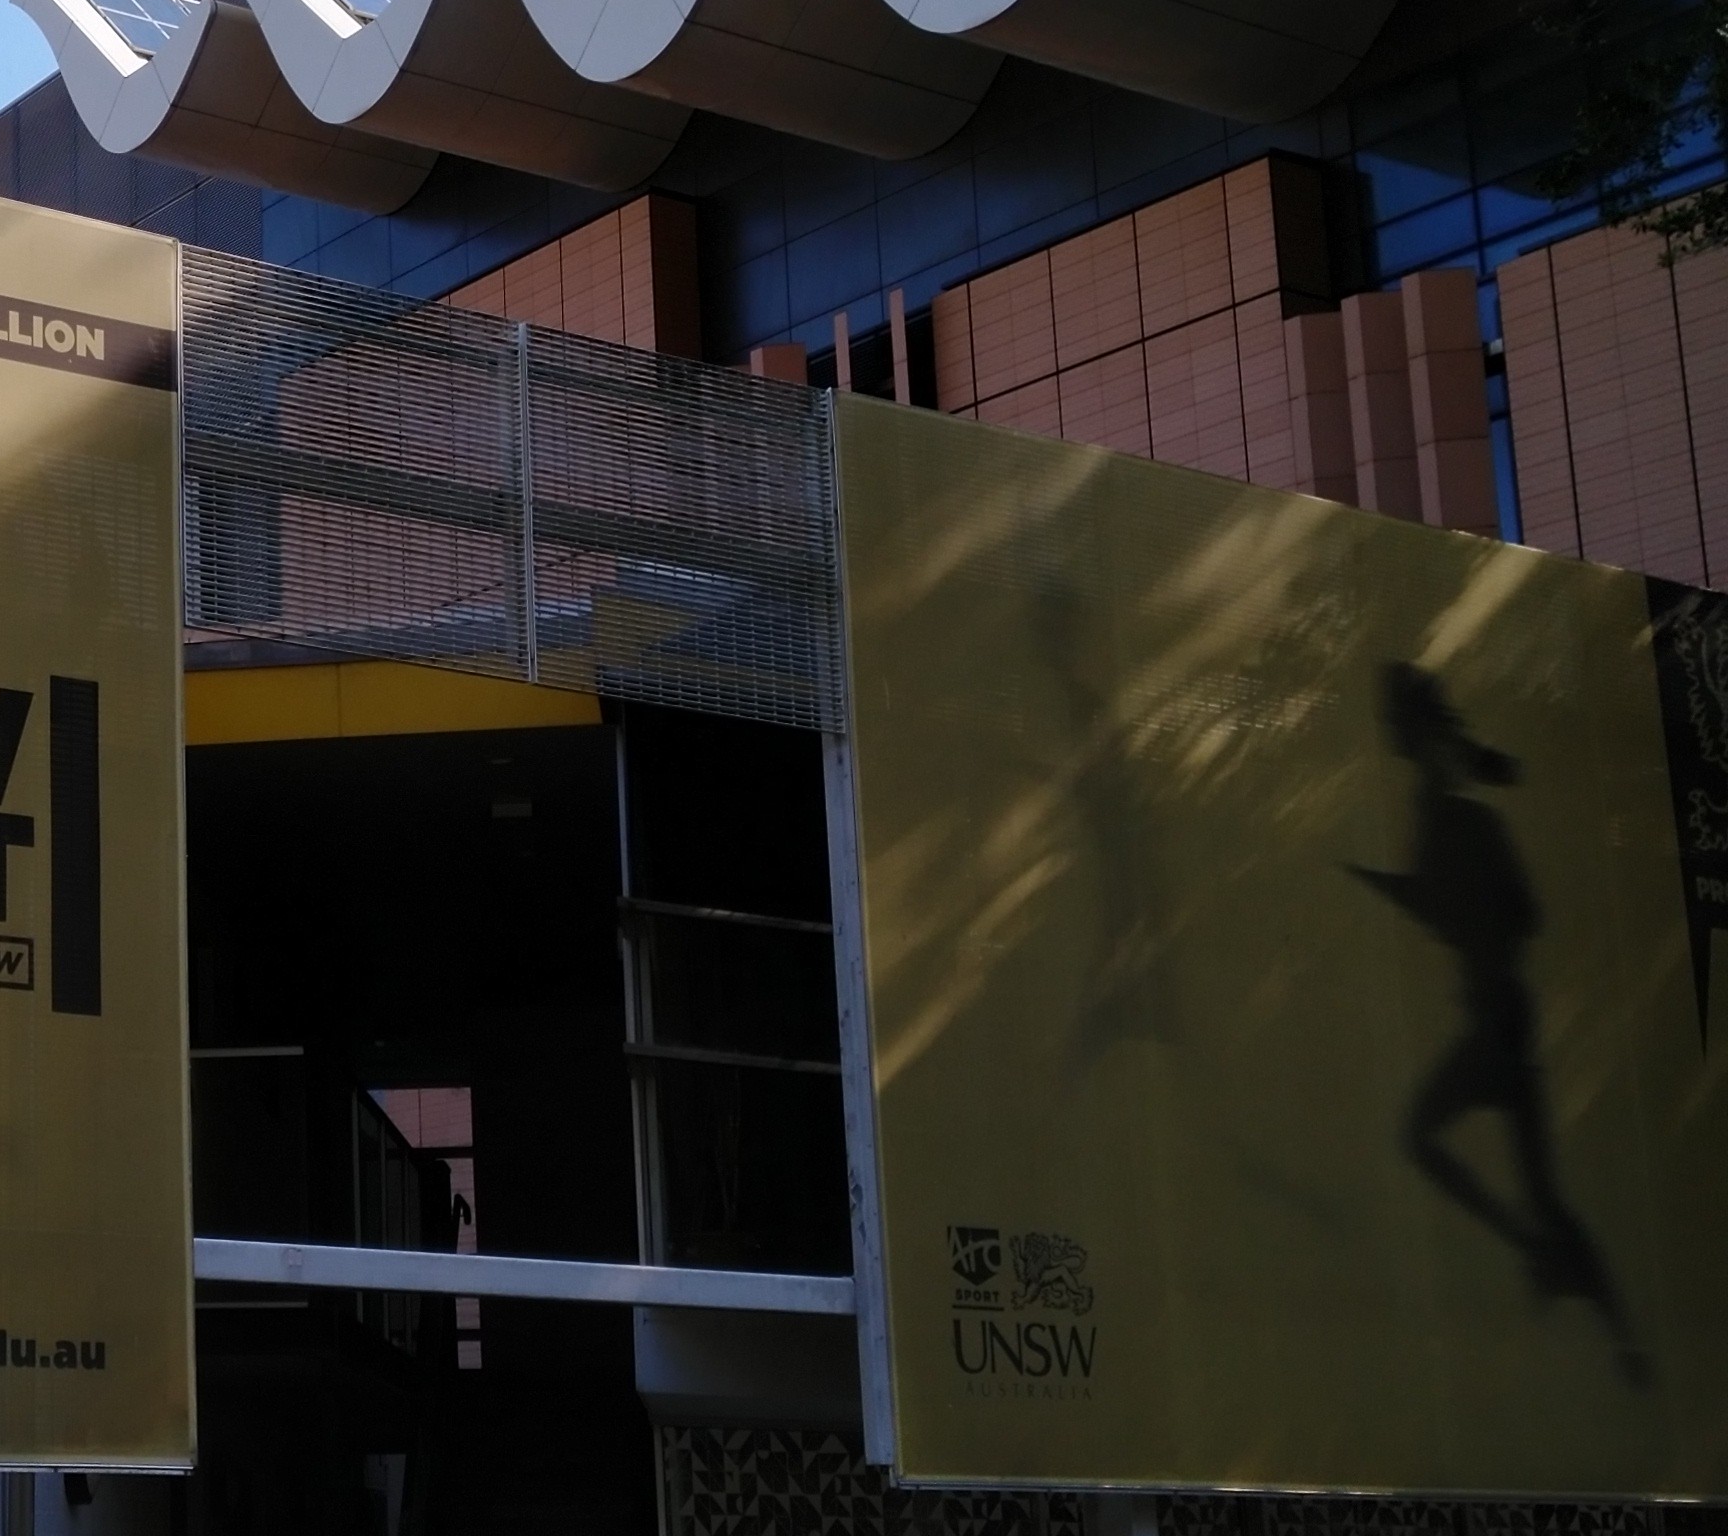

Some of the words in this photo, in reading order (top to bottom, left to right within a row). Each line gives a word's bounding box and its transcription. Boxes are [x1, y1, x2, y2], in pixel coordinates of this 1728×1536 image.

[1695, 876, 1728, 904] PR
[955, 1288, 1000, 1303] SPORT
[954, 1319, 1096, 1378] UNSW
[966, 1381, 1092, 1400] AUSTRALIA
